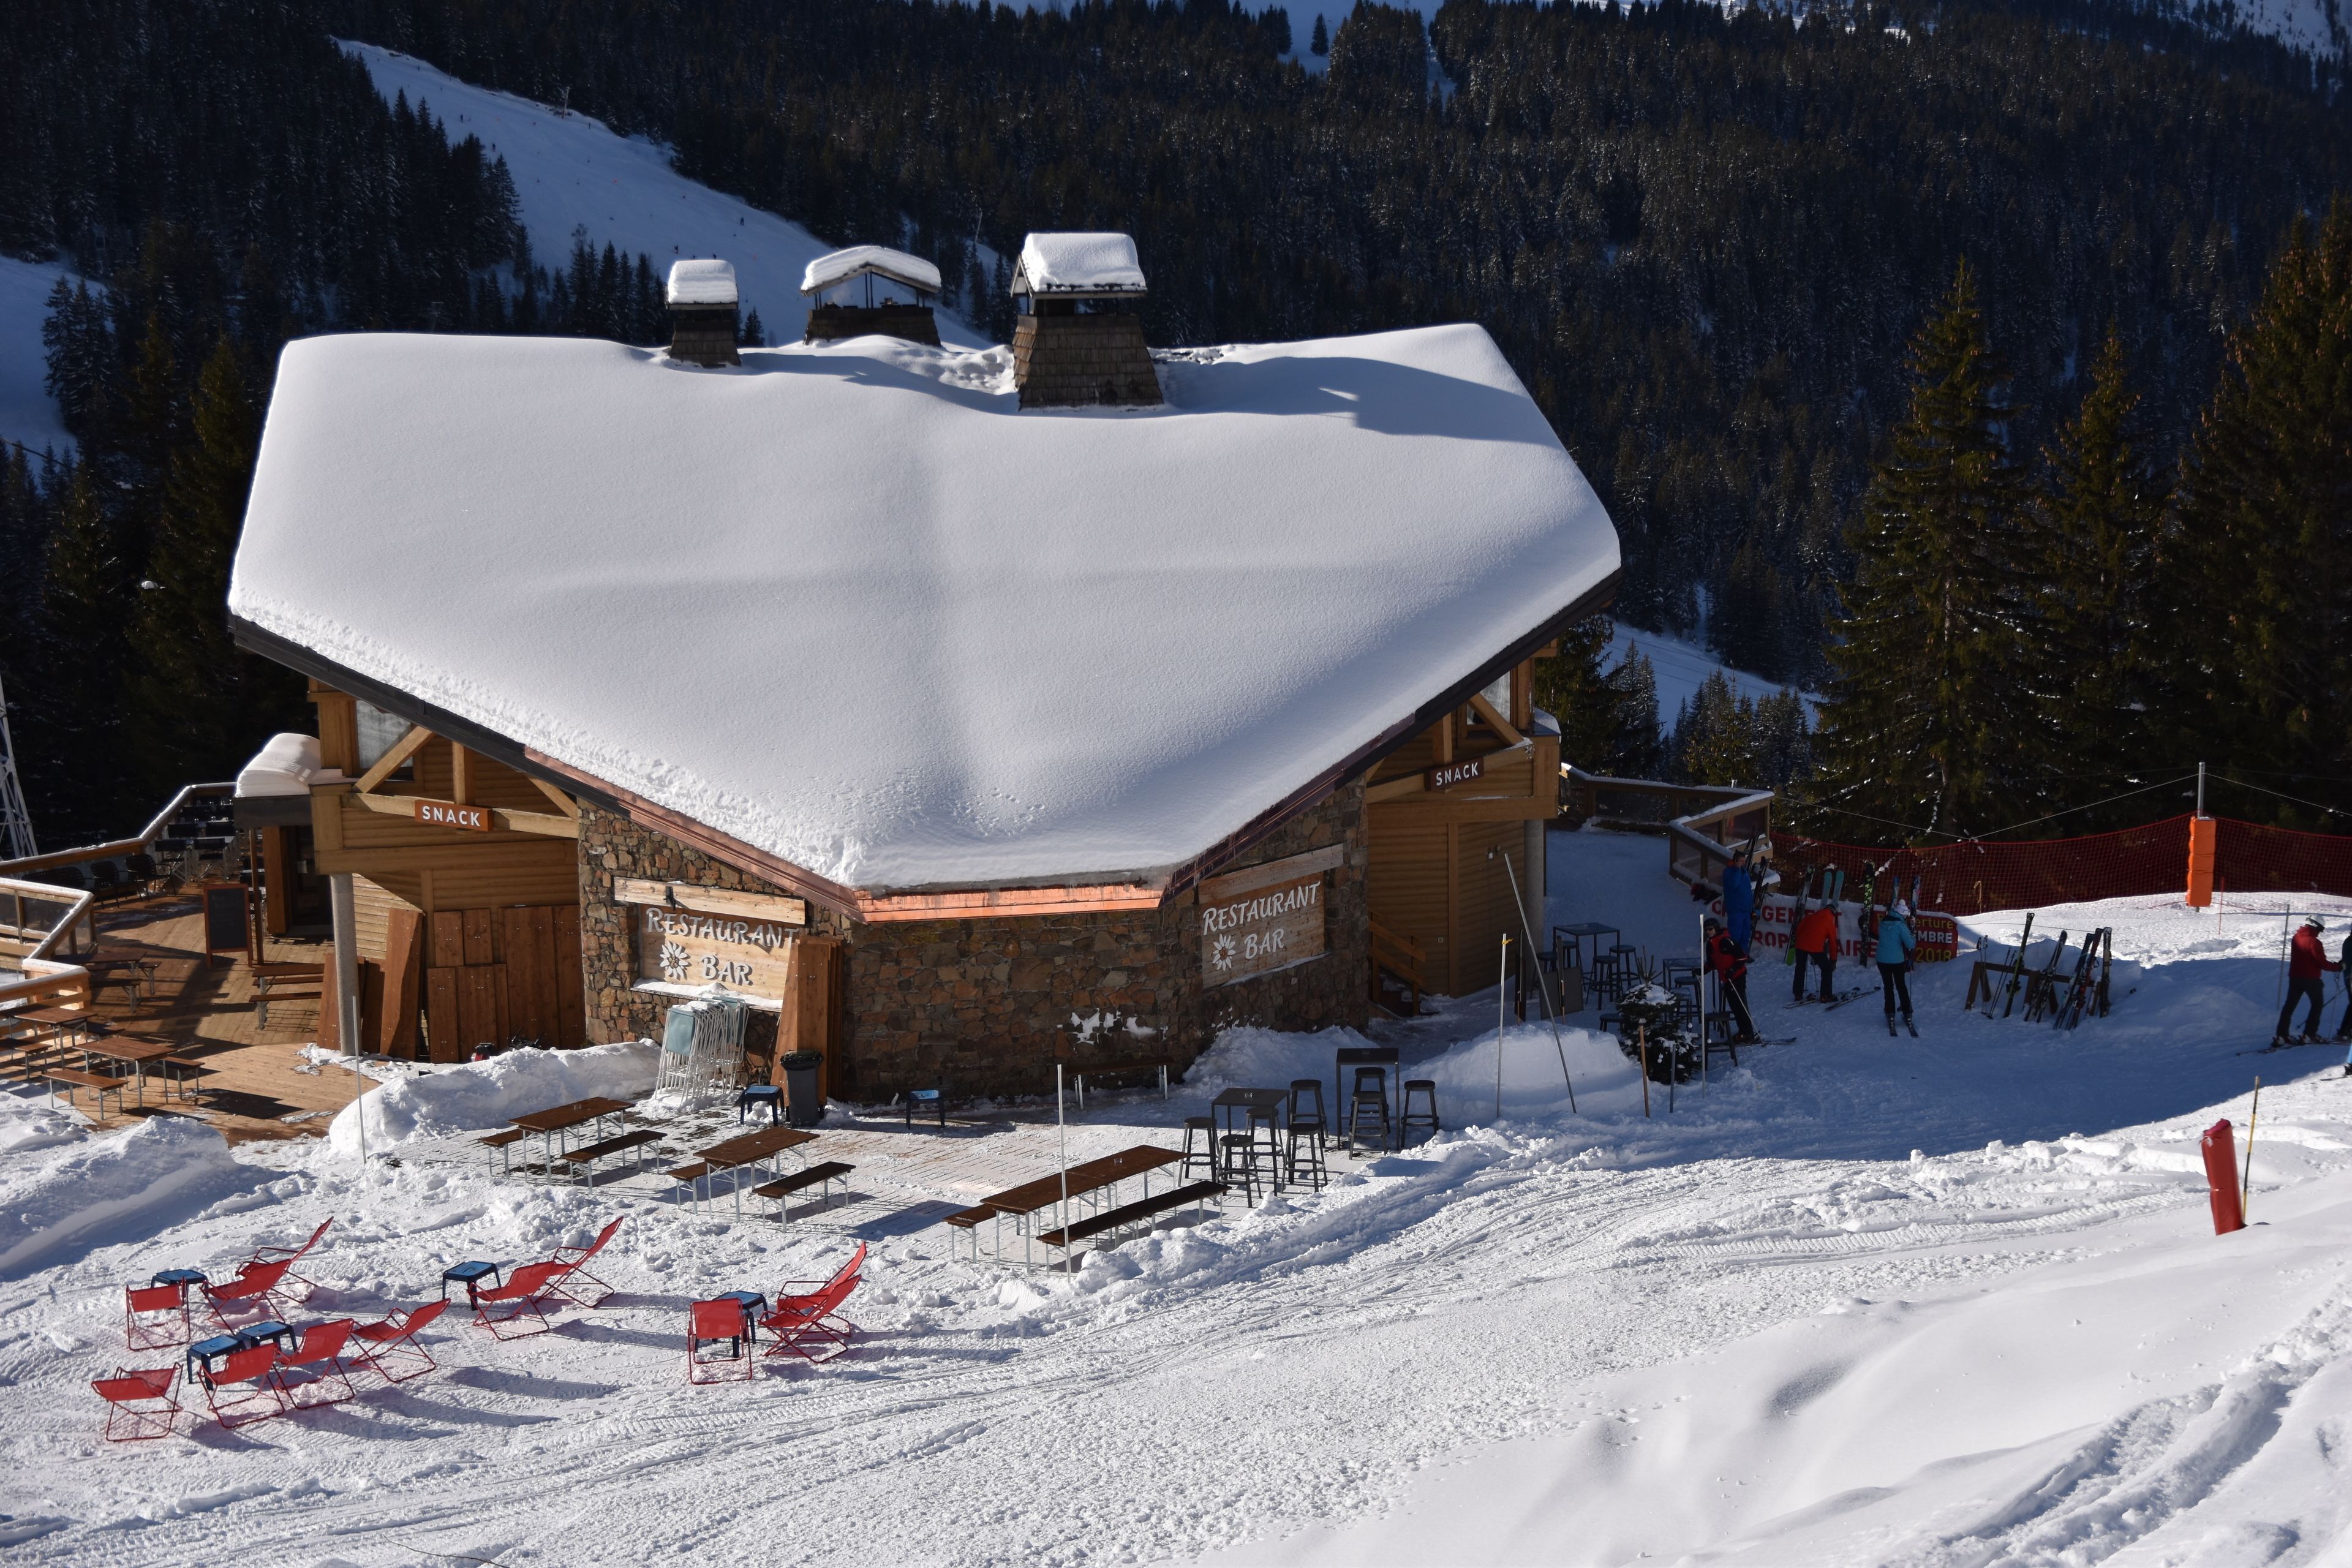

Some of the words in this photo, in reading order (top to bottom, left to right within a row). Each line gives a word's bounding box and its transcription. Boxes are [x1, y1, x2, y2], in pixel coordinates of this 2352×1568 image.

[1436, 762, 1479, 786] SNACK
[423, 805, 480, 827] SNACK
[1202, 881, 1321, 935] RESTAURANT
[646, 907, 799, 949] RESTAURANT
[1244, 929, 1284, 960] BAR
[1915, 947, 1951, 963] 2018
[701, 955, 752, 984] BAR
